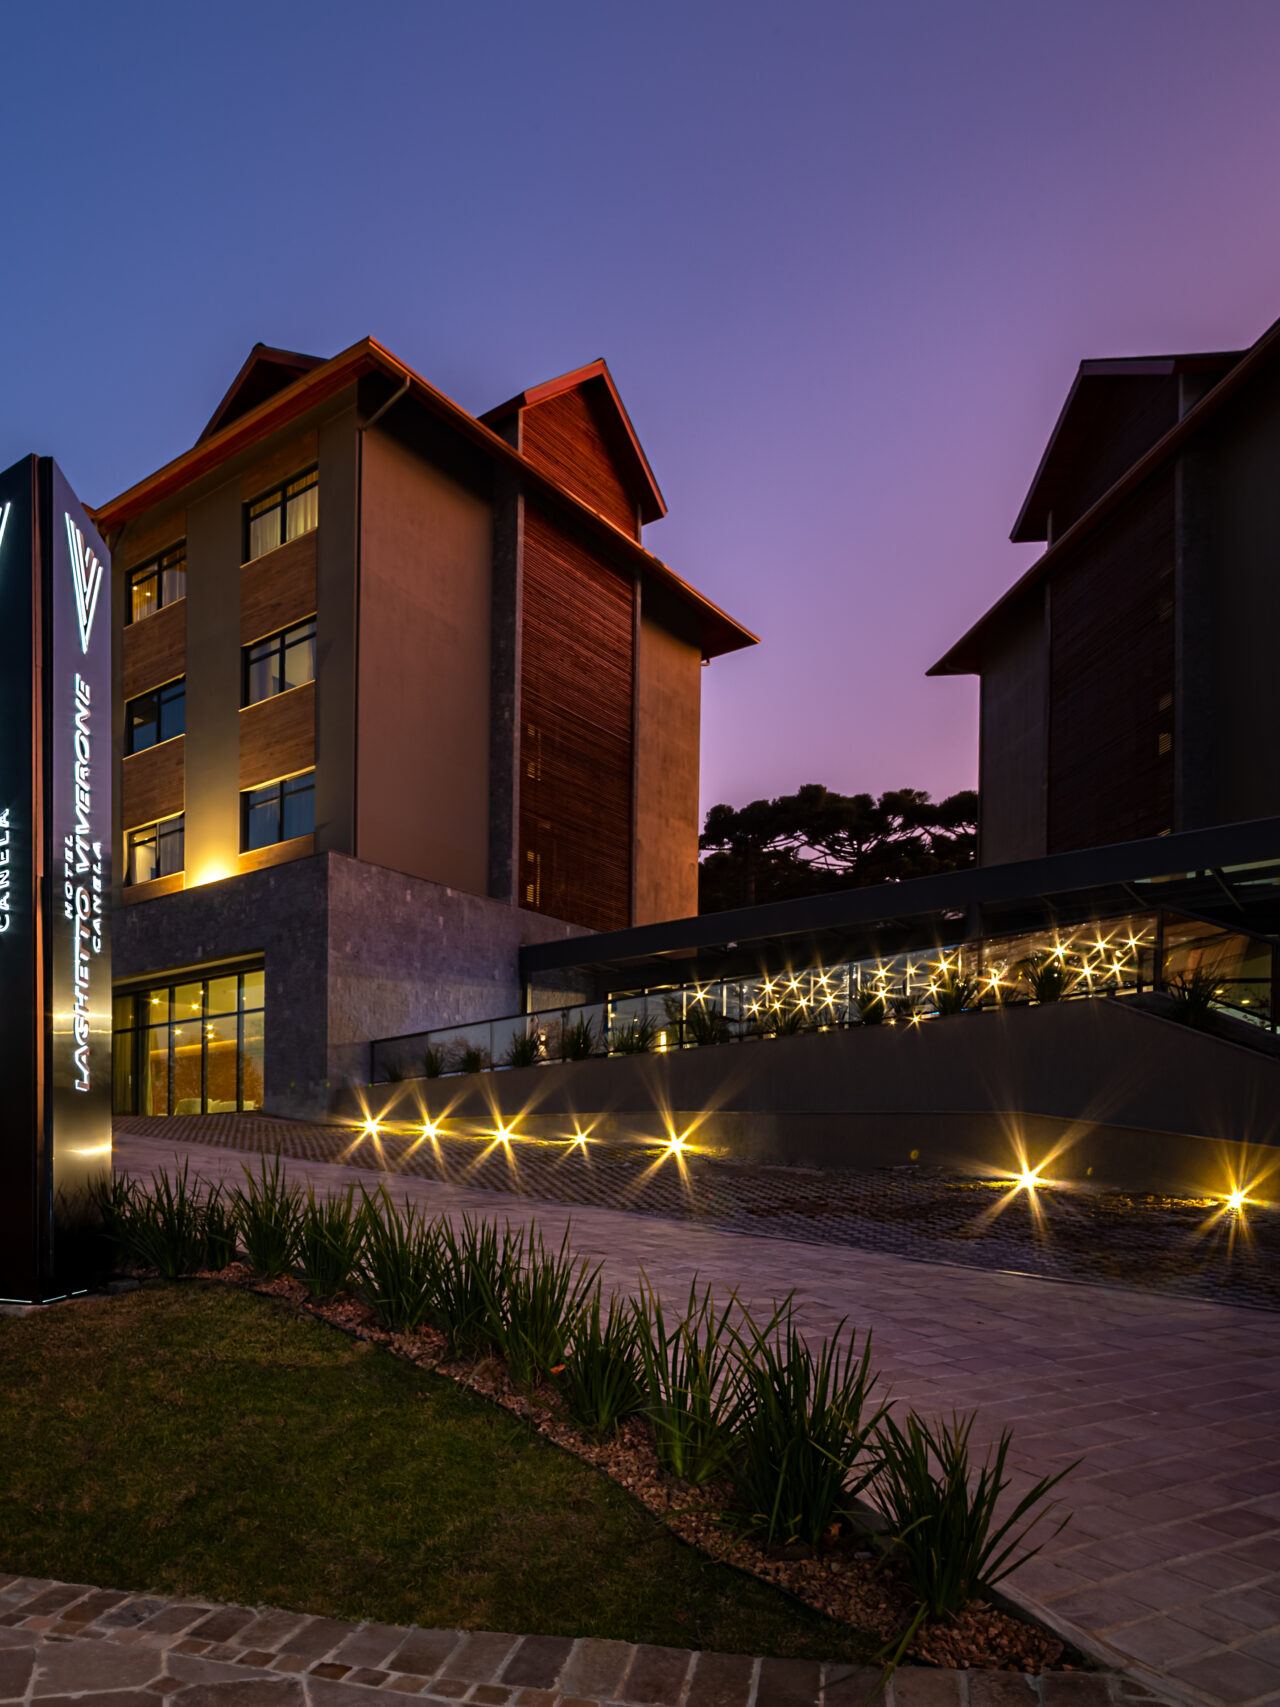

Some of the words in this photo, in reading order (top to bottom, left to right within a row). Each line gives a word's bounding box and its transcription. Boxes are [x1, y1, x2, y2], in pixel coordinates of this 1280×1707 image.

[74, 673, 92, 874] VIVERONE
[64, 834, 74, 920] HOTEL
[92, 841, 103, 953] CANELA
[73, 886, 91, 1092] LAGHETTO
